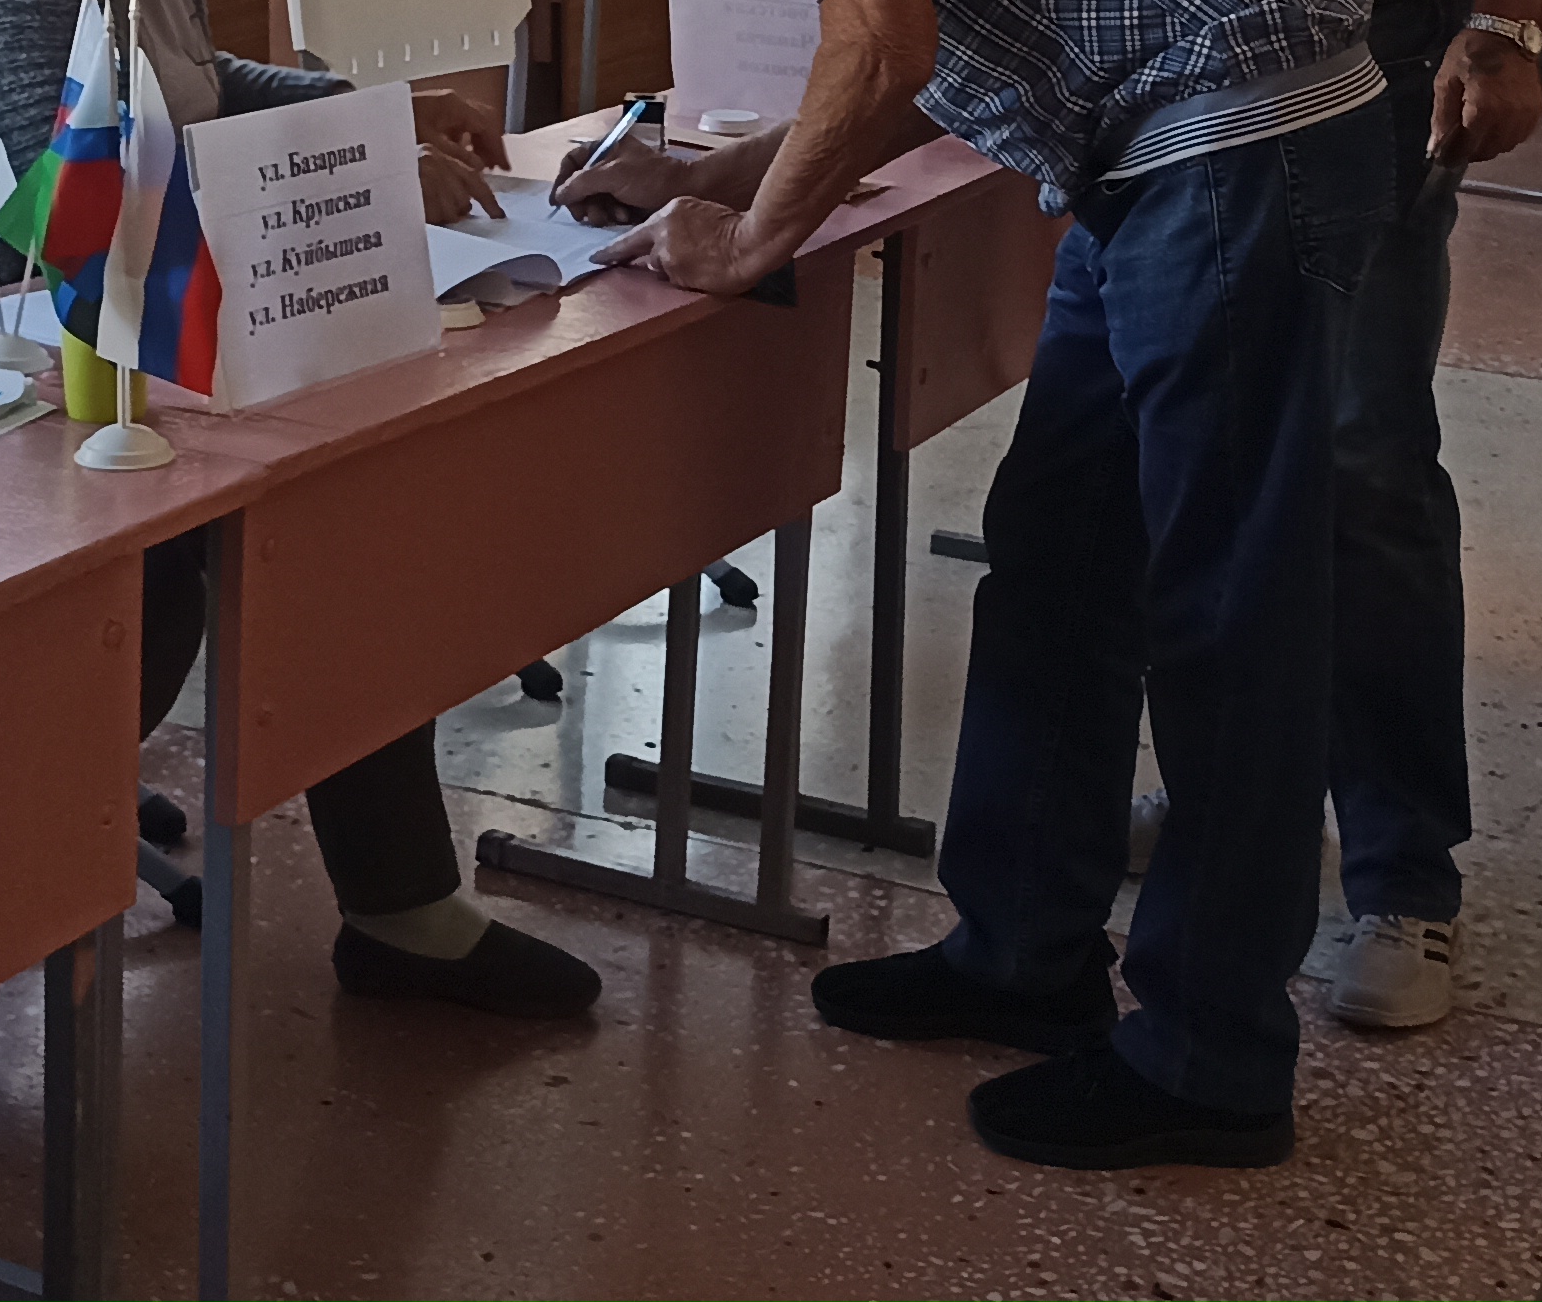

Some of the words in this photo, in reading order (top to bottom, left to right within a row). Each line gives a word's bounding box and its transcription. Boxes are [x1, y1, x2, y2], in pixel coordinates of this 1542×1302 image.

[258, 163, 285, 191] ул.
[287, 143, 367, 175] Базарная
[261, 211, 287, 240] ул.
[291, 188, 371, 228] Крупская
[250, 260, 276, 288] ул.
[281, 231, 383, 276] Куйбышева
[249, 306, 276, 335] ул.
[280, 274, 389, 319] Набережная
